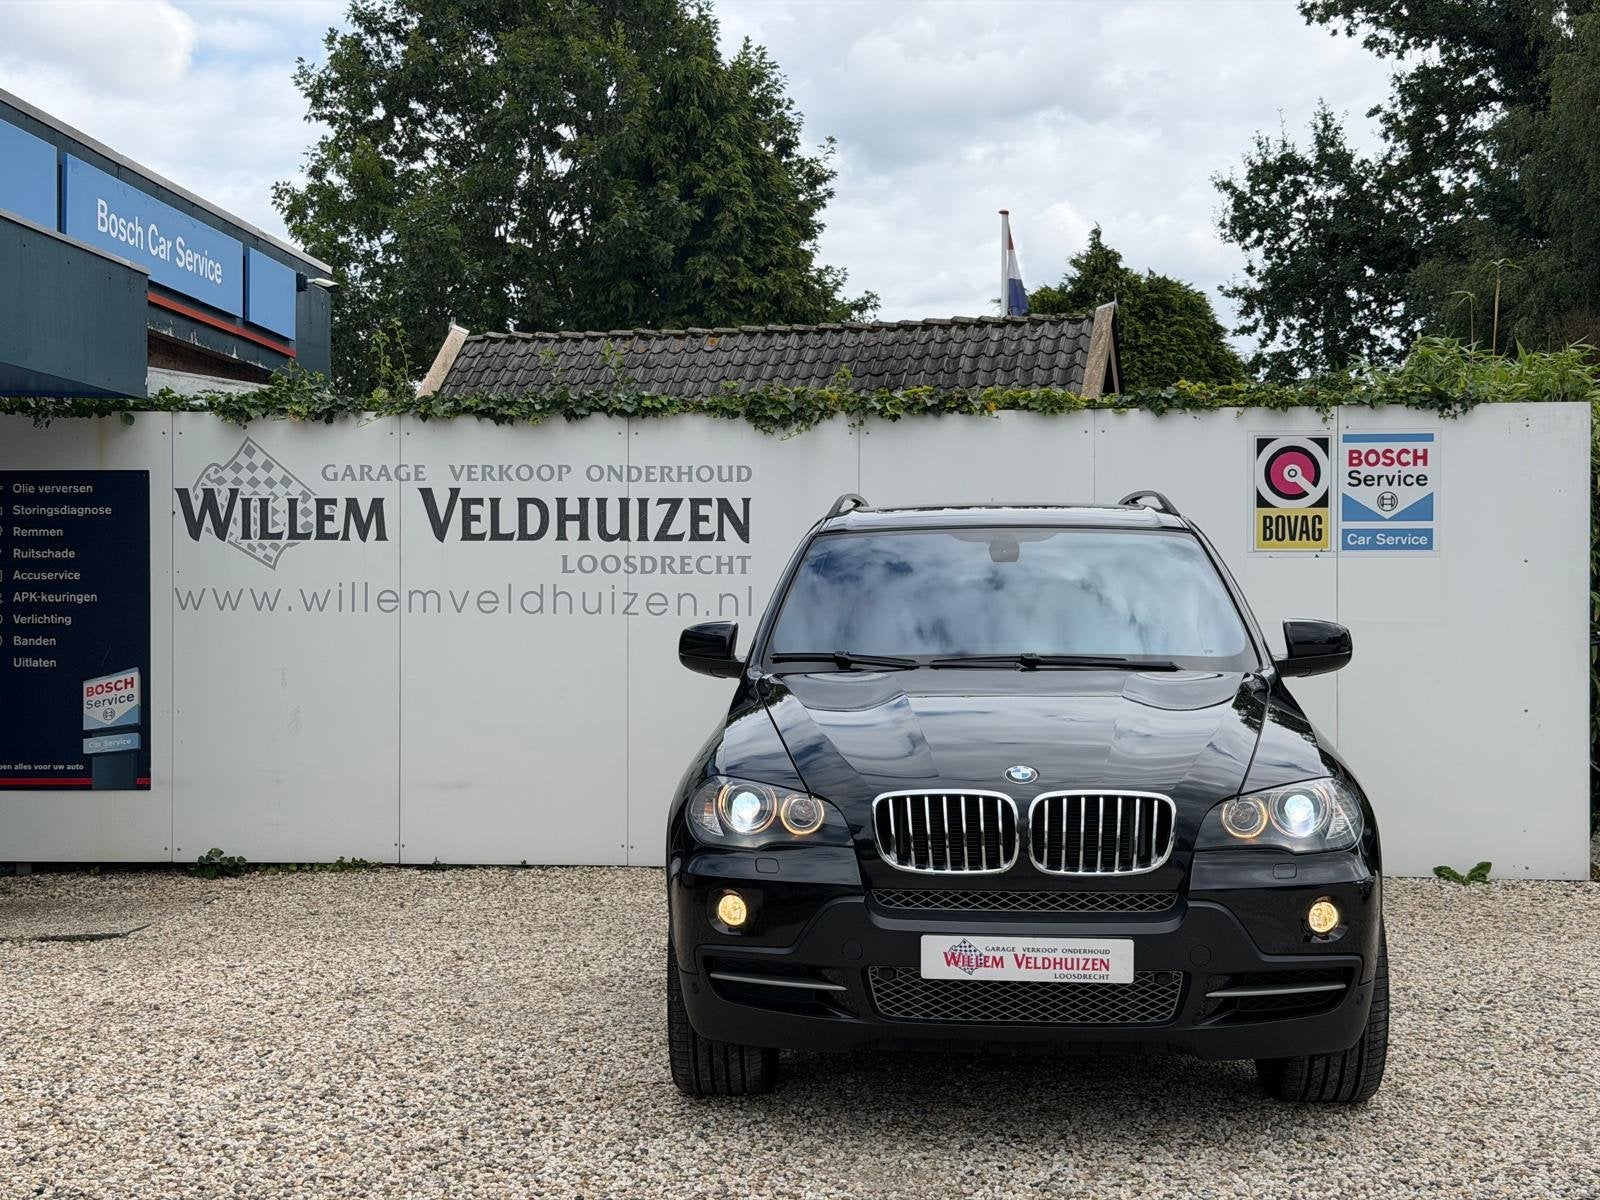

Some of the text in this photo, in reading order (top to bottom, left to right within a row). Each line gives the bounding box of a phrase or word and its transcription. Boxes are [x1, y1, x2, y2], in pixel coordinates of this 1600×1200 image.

[96, 198, 223, 285] Bosch Car Service
[1347, 448, 1429, 468] BOSCH
[321, 464, 753, 483] GARAGE VERKOOP ONDERHOUD
[1346, 470, 1429, 487] Service
[12, 483, 94, 494] Olie verversen
[12, 504, 113, 516] Storingsdiagnose
[174, 487, 751, 544] WILLEM VELDHUIZEN
[13, 526, 64, 537] Remmen
[1262, 515, 1323, 542] BOVAG
[1346, 533, 1428, 546] Car Service
[13, 548, 76, 559] Ruitschade
[560, 554, 752, 575] LOOSDRECHT
[13, 570, 81, 581] Accuservice
[13, 591, 98, 604] APK-keuringen
[174, 583, 753, 617] www.willemveldhuizen.nl
[13, 613, 72, 626] Verlichting
[13, 636, 57, 647] Banden
[13, 657, 57, 668] Uitlaten
[86, 677, 134, 697] BOSCH
[86, 693, 135, 710] Service
[943, 952, 1110, 972] WILLEM VELDHUIZEN
[1054, 973, 1110, 981] LOOSDRECHT
